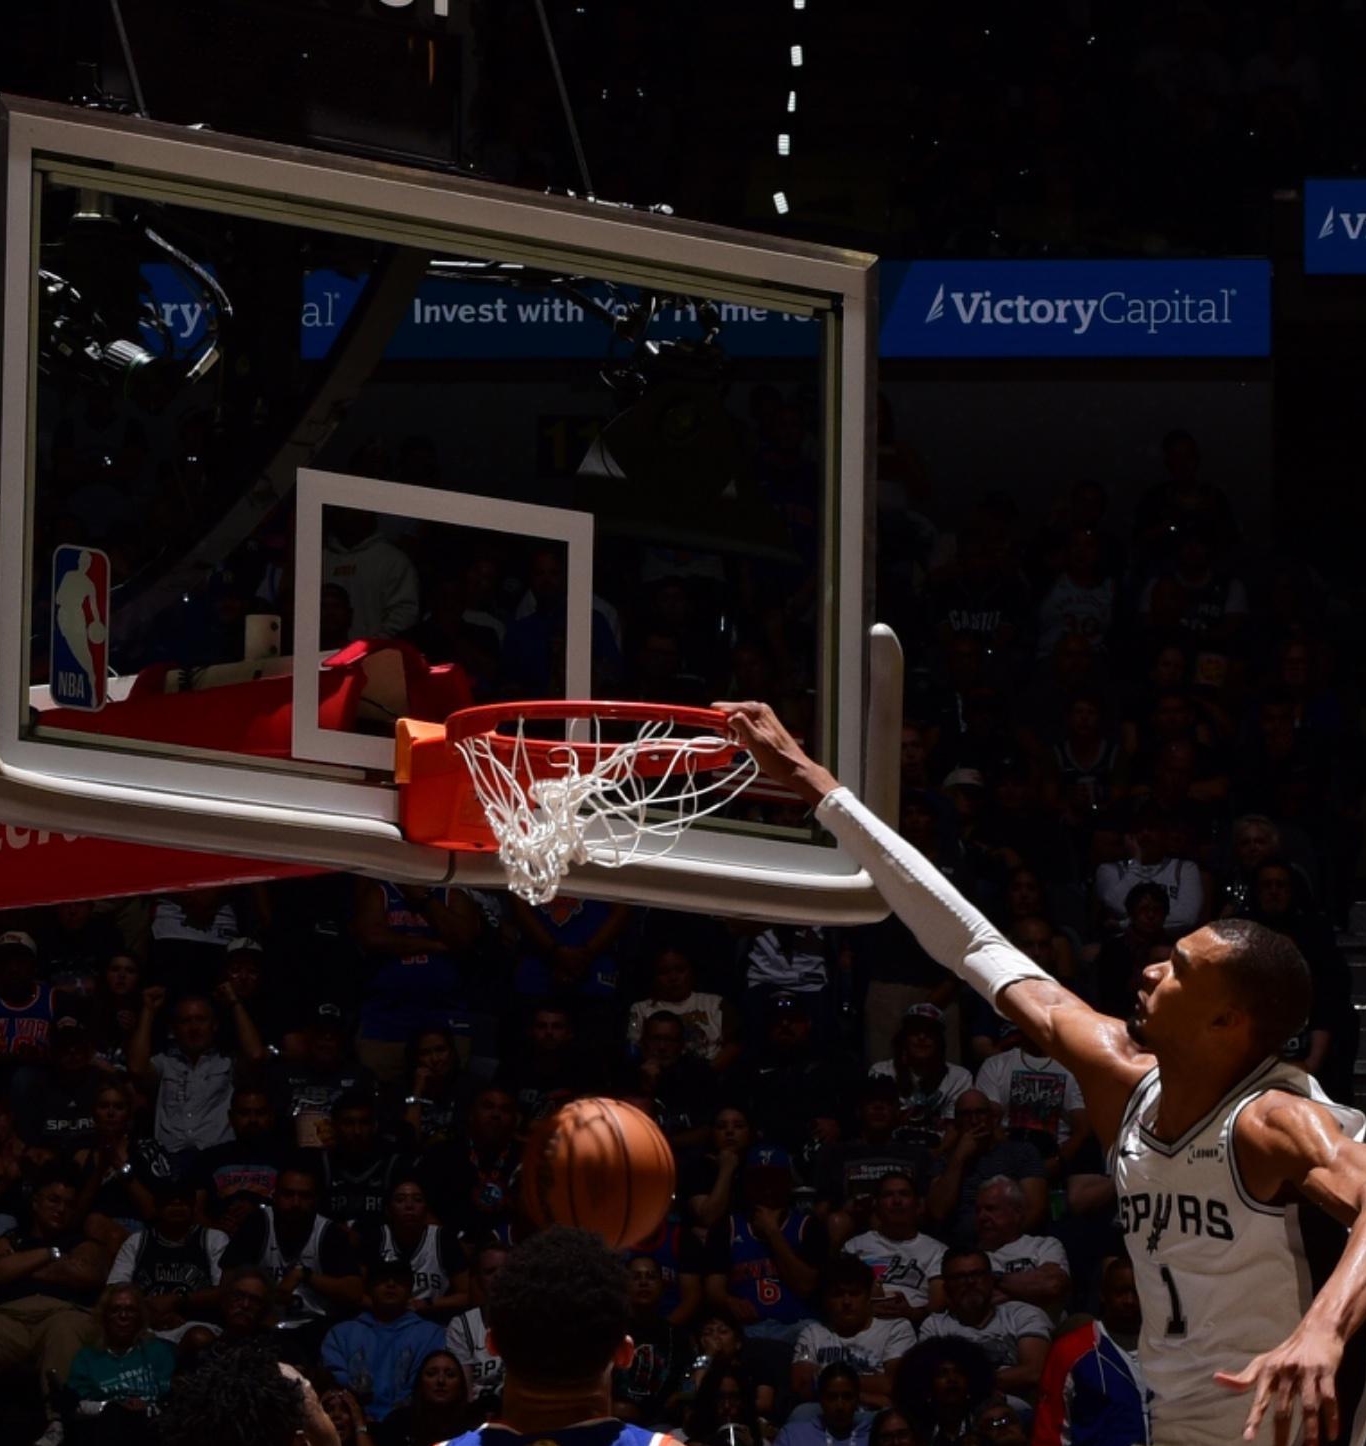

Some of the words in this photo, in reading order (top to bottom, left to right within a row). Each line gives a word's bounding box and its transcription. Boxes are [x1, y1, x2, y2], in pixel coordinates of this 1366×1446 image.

[414, 298, 509, 322] Invest
[517, 297, 586, 322] with
[951, 289, 1235, 335] VictoryCapital
[58, 671, 85, 699] NBA
[45, 1118, 94, 1131] SPUR
[1120, 1192, 1234, 1253] SPURS
[1160, 1265, 1186, 1336] 1
